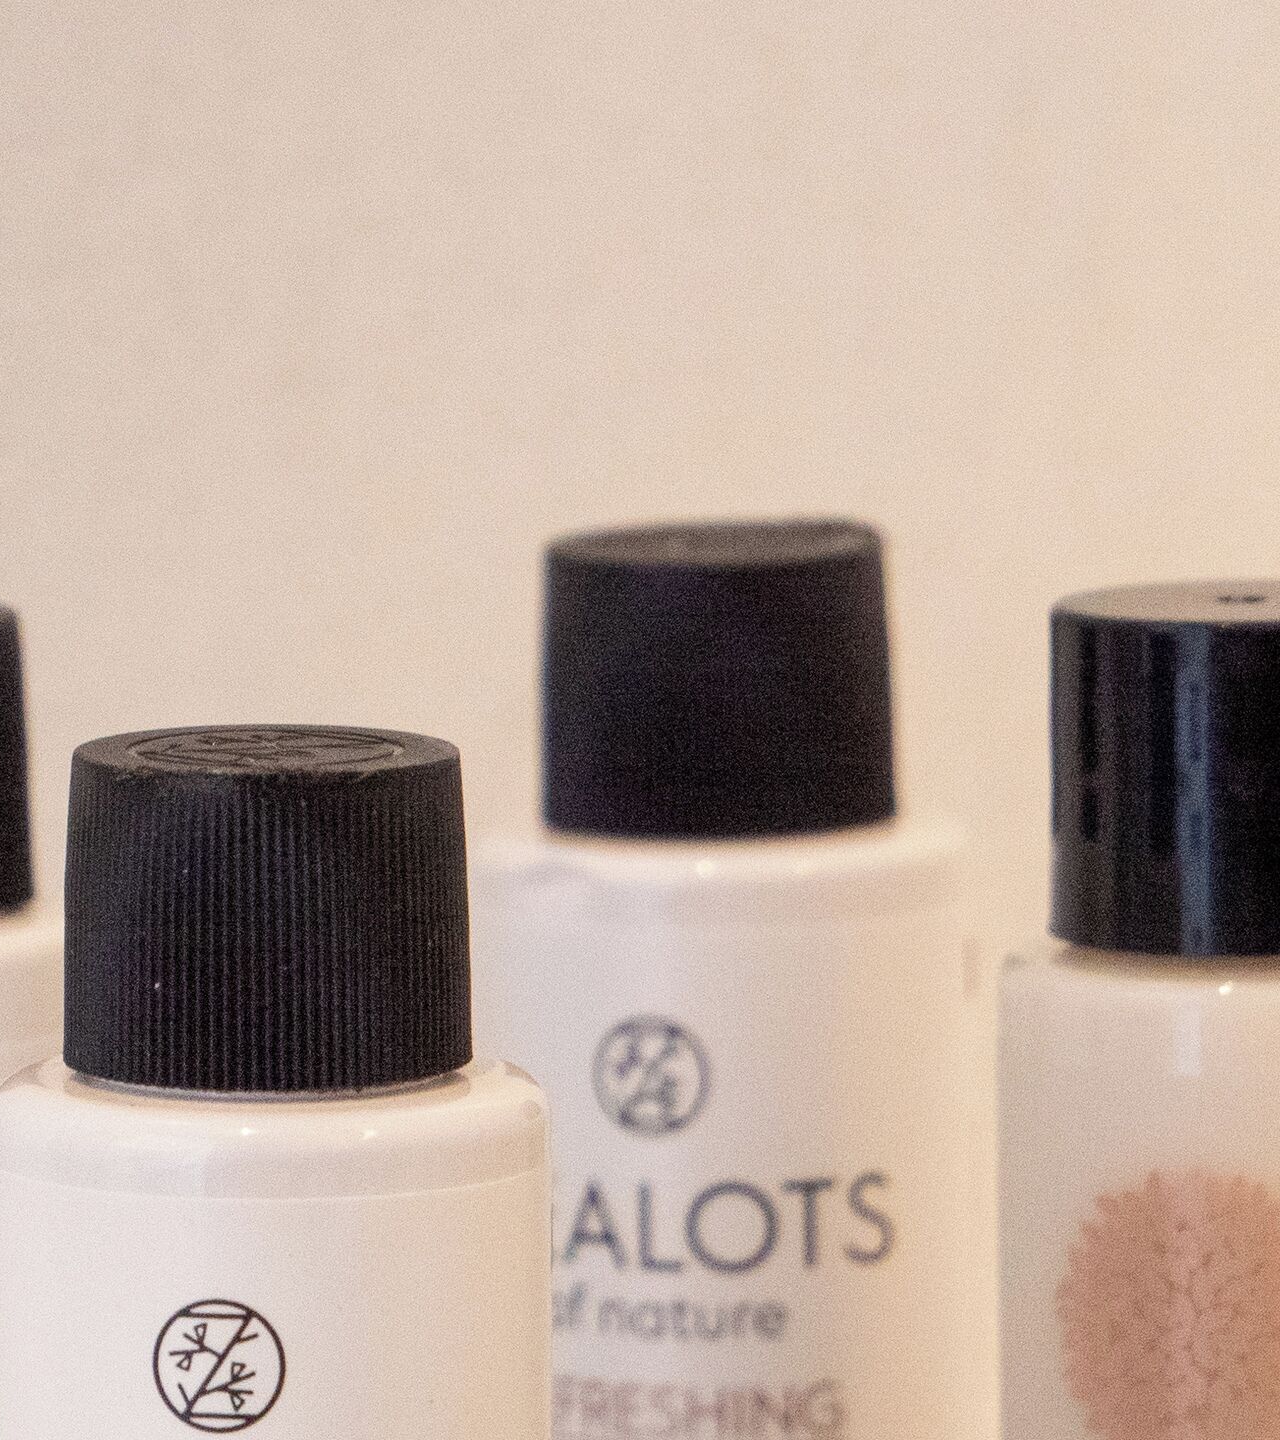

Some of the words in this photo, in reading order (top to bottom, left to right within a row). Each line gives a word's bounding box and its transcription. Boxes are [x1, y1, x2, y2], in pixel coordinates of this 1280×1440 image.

[556, 1171, 895, 1274] ALOTS
[596, 1297, 790, 1341] nature
[551, 1376, 847, 1440] FRESHING
